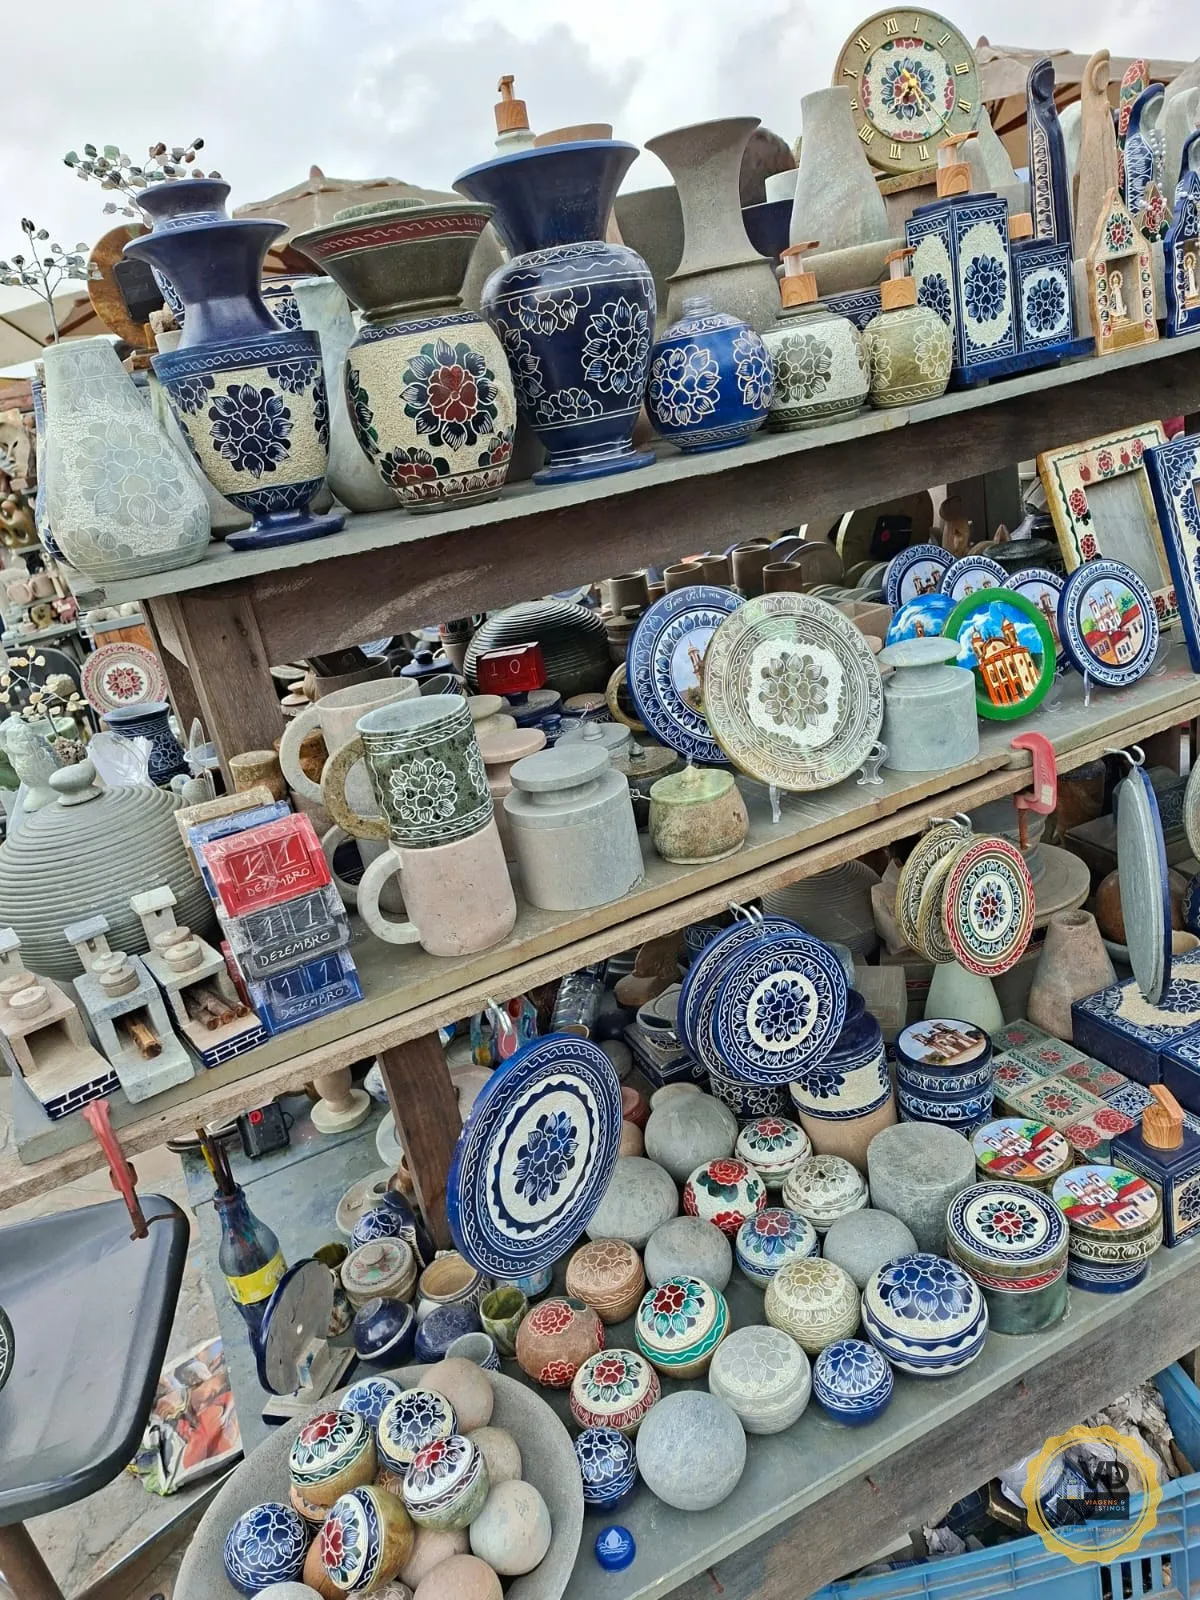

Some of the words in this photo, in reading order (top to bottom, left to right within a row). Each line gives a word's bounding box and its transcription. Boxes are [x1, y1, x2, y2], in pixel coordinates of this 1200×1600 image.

[884, 18, 899, 35] XII
[913, 17, 920, 33] I
[855, 36, 870, 52] XI
[938, 33, 950, 47] II
[843, 68, 858, 78] X
[955, 62, 969, 74] III
[260, 932, 331, 967] DEZEMBRO
[280, 987, 344, 1021] DEZEMBRO
